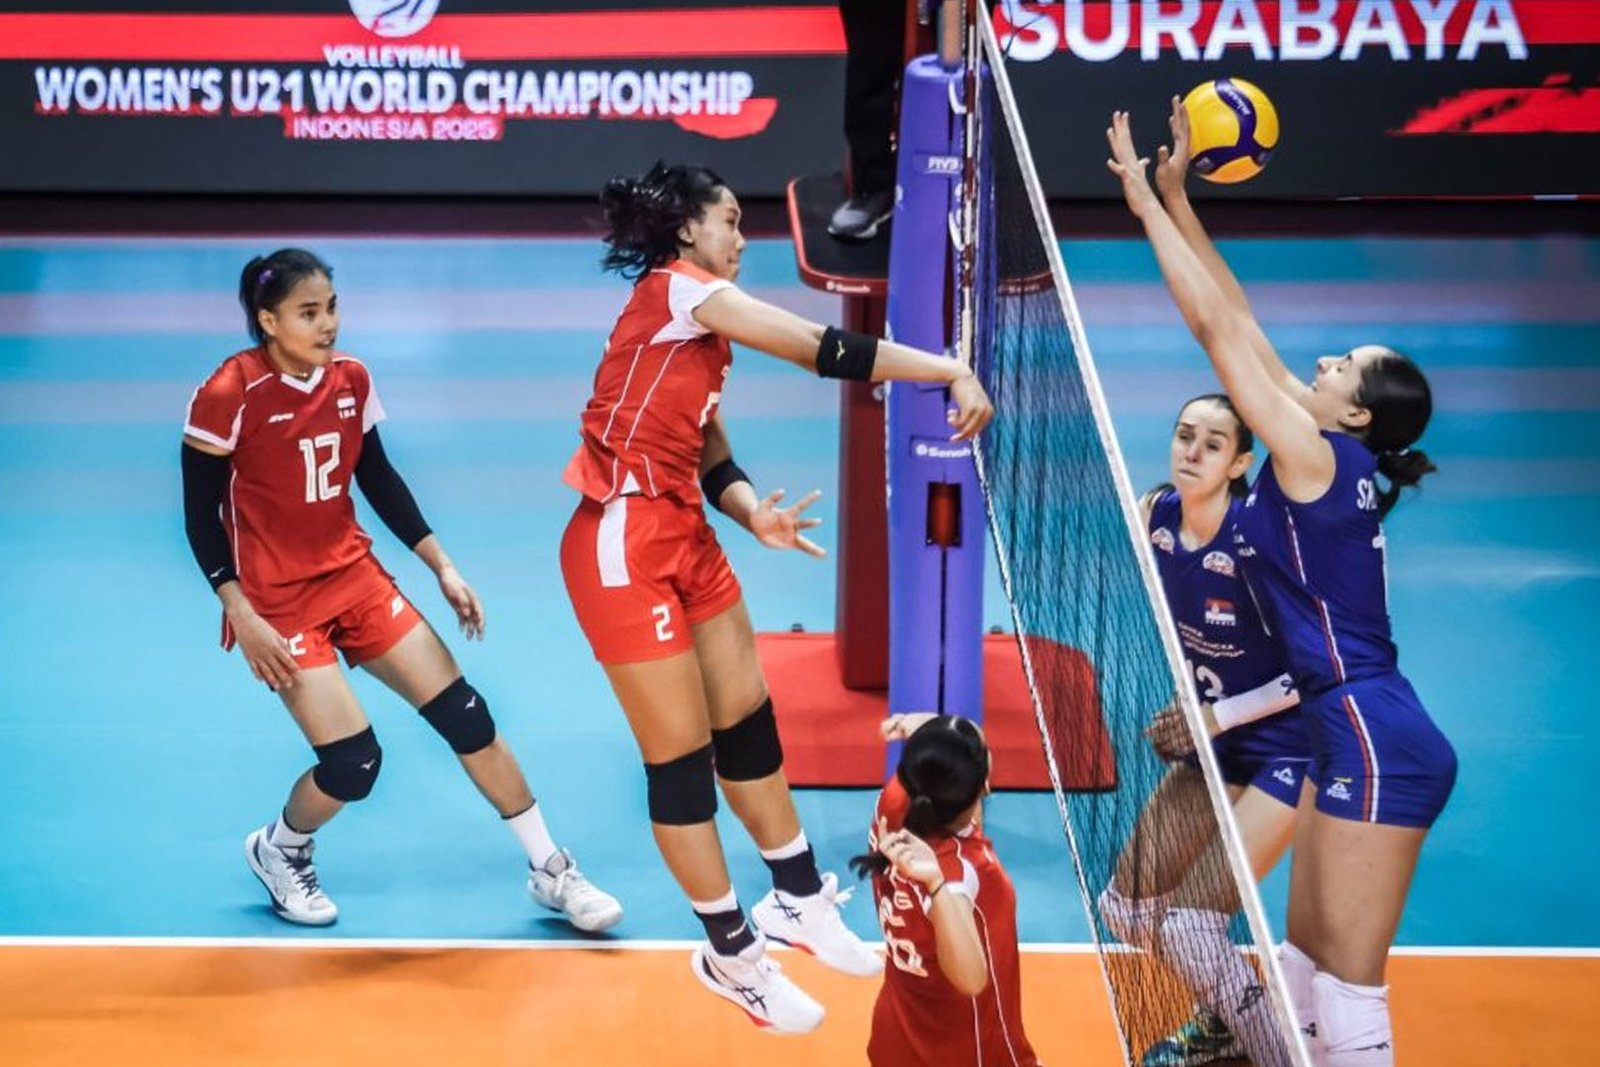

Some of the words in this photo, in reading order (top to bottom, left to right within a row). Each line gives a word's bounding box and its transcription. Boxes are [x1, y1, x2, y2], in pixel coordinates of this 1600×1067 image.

[1000, 0, 1530, 61] SURABAYA
[322, 45, 465, 69] VOLLEYBALL
[35, 66, 223, 113] WOMEN'S
[230, 69, 304, 113] U21
[309, 69, 458, 115] WORLD
[462, 69, 755, 116] CHAMPIONSHIP
[293, 116, 428, 140] INDONESIA
[432, 118, 498, 140] 2025
[298, 431, 342, 503] 12
[651, 602, 675, 642] 2
